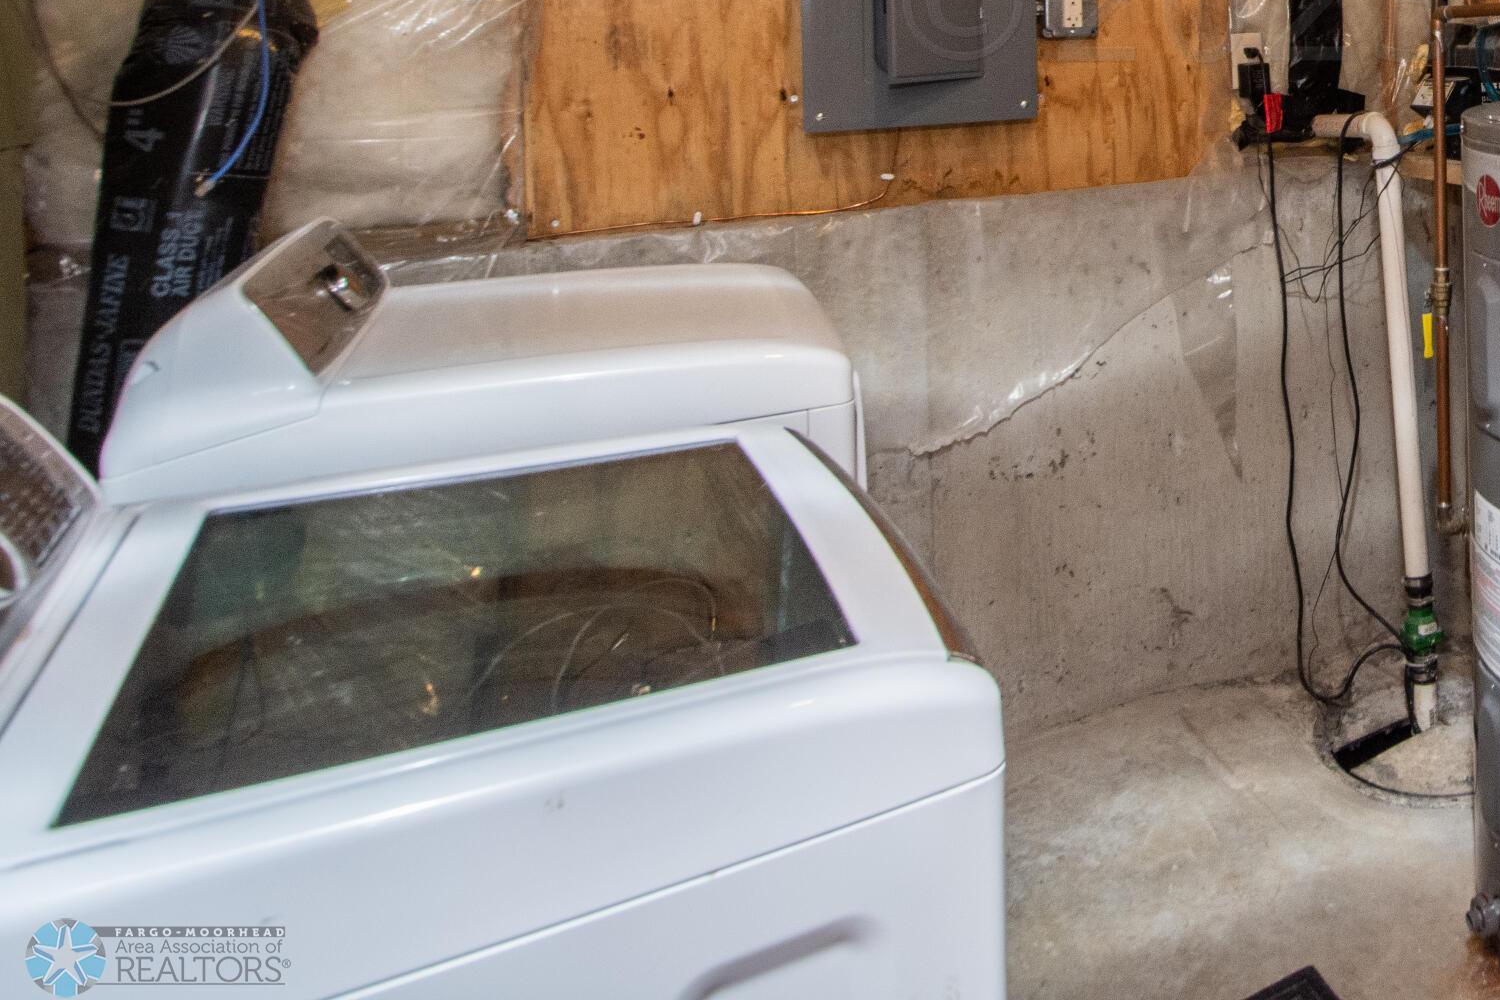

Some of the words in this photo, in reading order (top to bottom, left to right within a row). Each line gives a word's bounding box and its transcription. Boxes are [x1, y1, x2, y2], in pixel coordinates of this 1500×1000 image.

[149, 226, 179, 298] CLASS
[177, 208, 204, 262] DUCT
[173, 264, 193, 298] AIR
